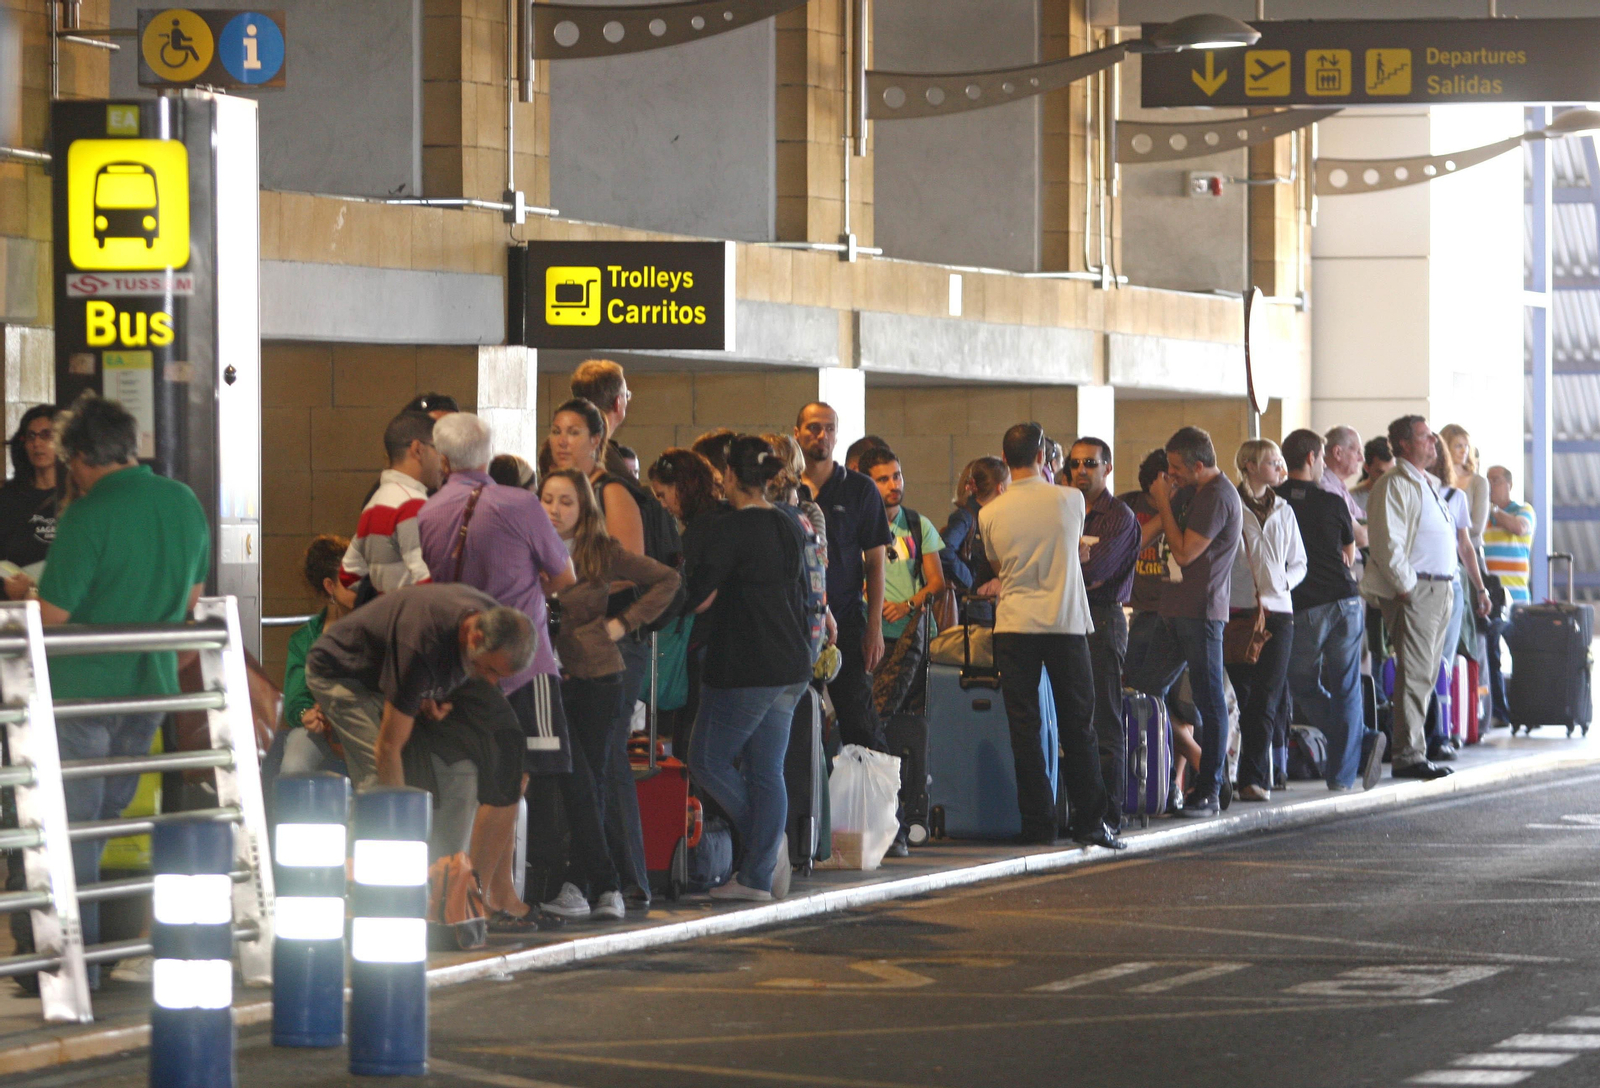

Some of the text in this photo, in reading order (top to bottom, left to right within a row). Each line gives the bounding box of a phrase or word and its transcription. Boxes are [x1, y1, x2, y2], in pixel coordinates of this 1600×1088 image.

[1426, 46, 1527, 68] Departures
[1426, 74, 1504, 95] Salidas
[109, 110, 138, 128] EA
[607, 265, 694, 293] Trolleys
[86, 300, 175, 347] Bus
[607, 298, 707, 325] Carritos
